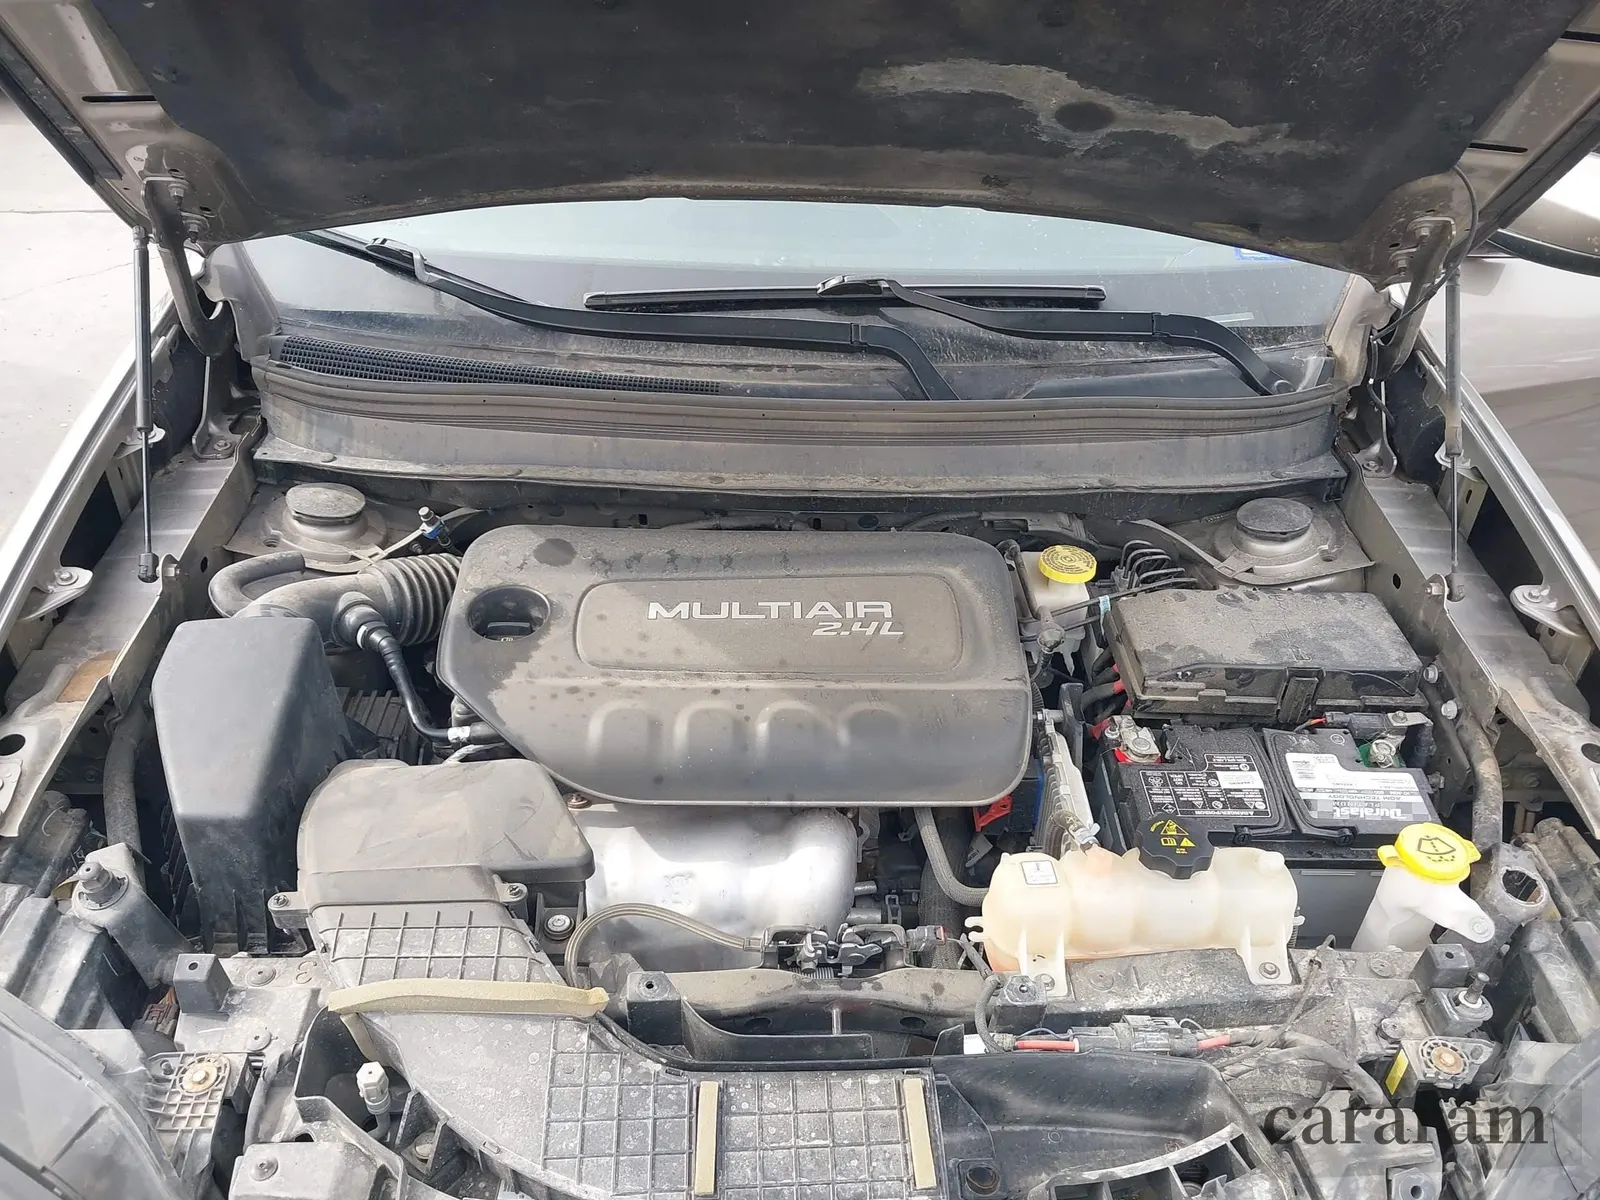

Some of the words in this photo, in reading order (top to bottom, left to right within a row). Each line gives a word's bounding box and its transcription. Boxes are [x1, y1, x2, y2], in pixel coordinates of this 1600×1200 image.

[647, 601, 894, 620] MULTIAIR
[811, 621, 905, 636] 2.4L
[1332, 807, 1408, 820] Duralast
